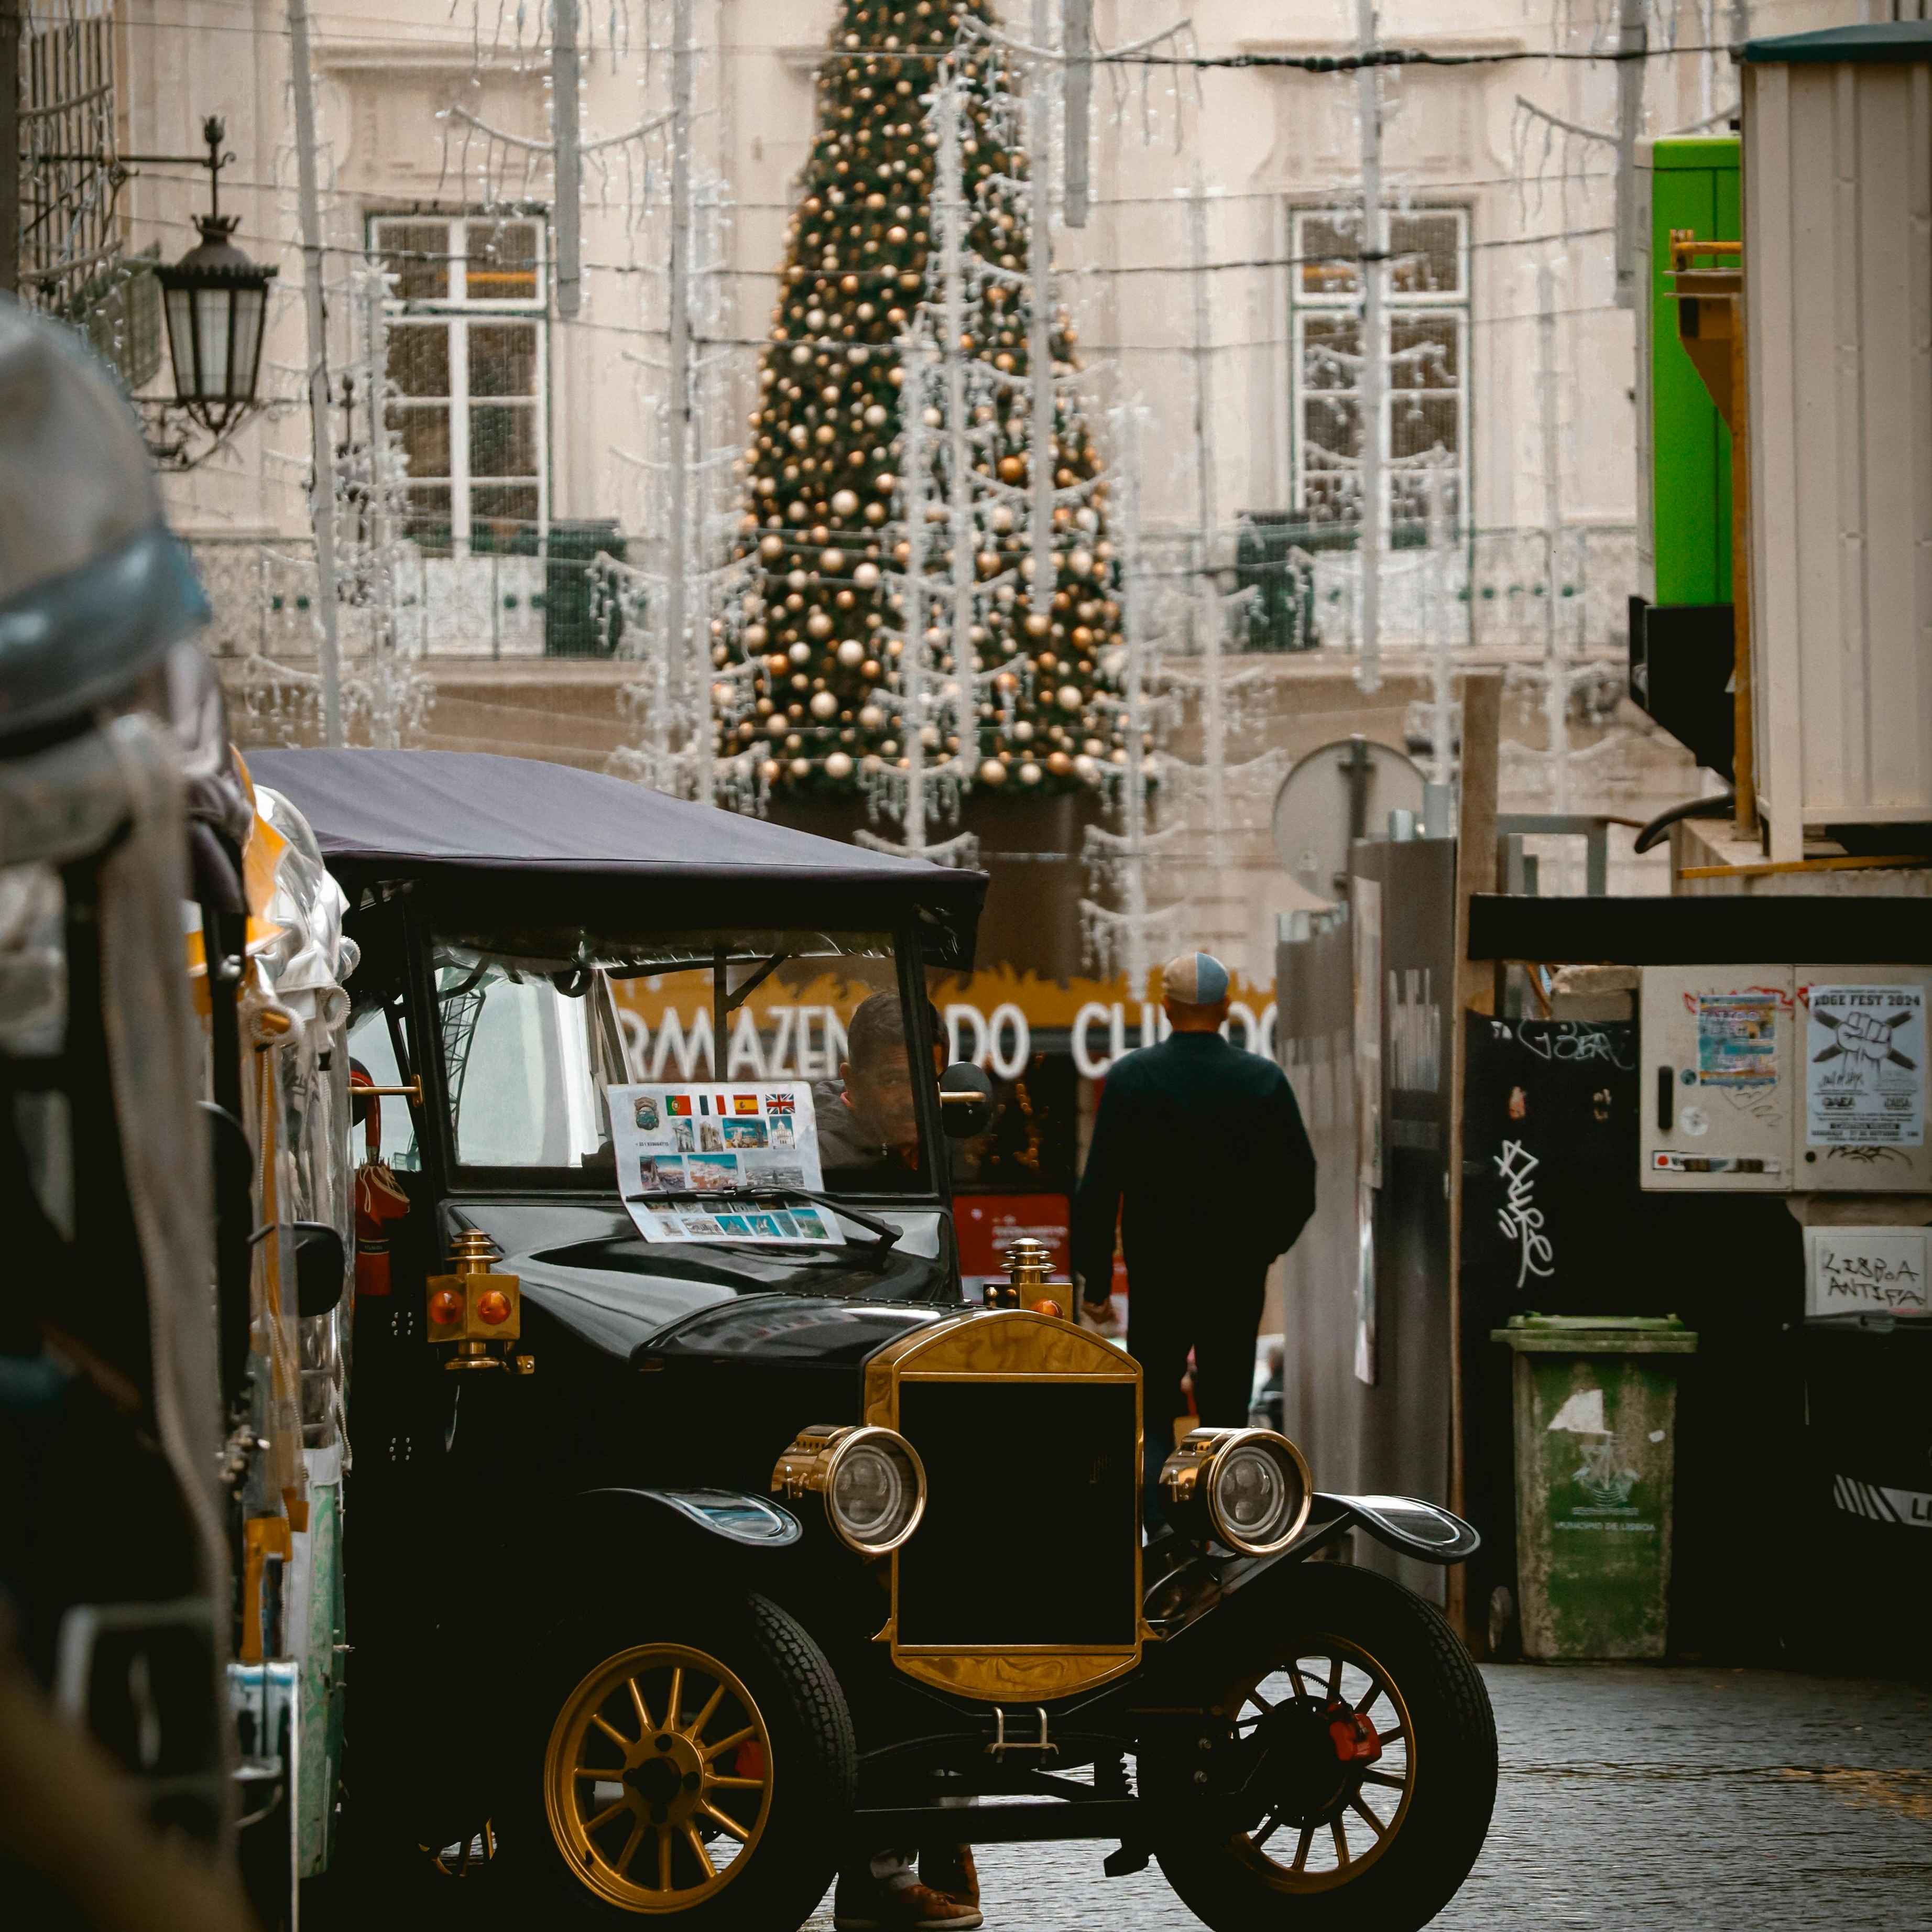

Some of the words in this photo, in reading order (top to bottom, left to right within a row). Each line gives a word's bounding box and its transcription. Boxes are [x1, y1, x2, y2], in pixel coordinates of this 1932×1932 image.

[1850, 995, 1884, 1006] FEST
[1888, 994, 1920, 1006] 2024
[618, 1004, 855, 1083] RMAZEN
[945, 1002, 1030, 1080] DO
[1827, 1276, 1927, 1306] ANTIFA
